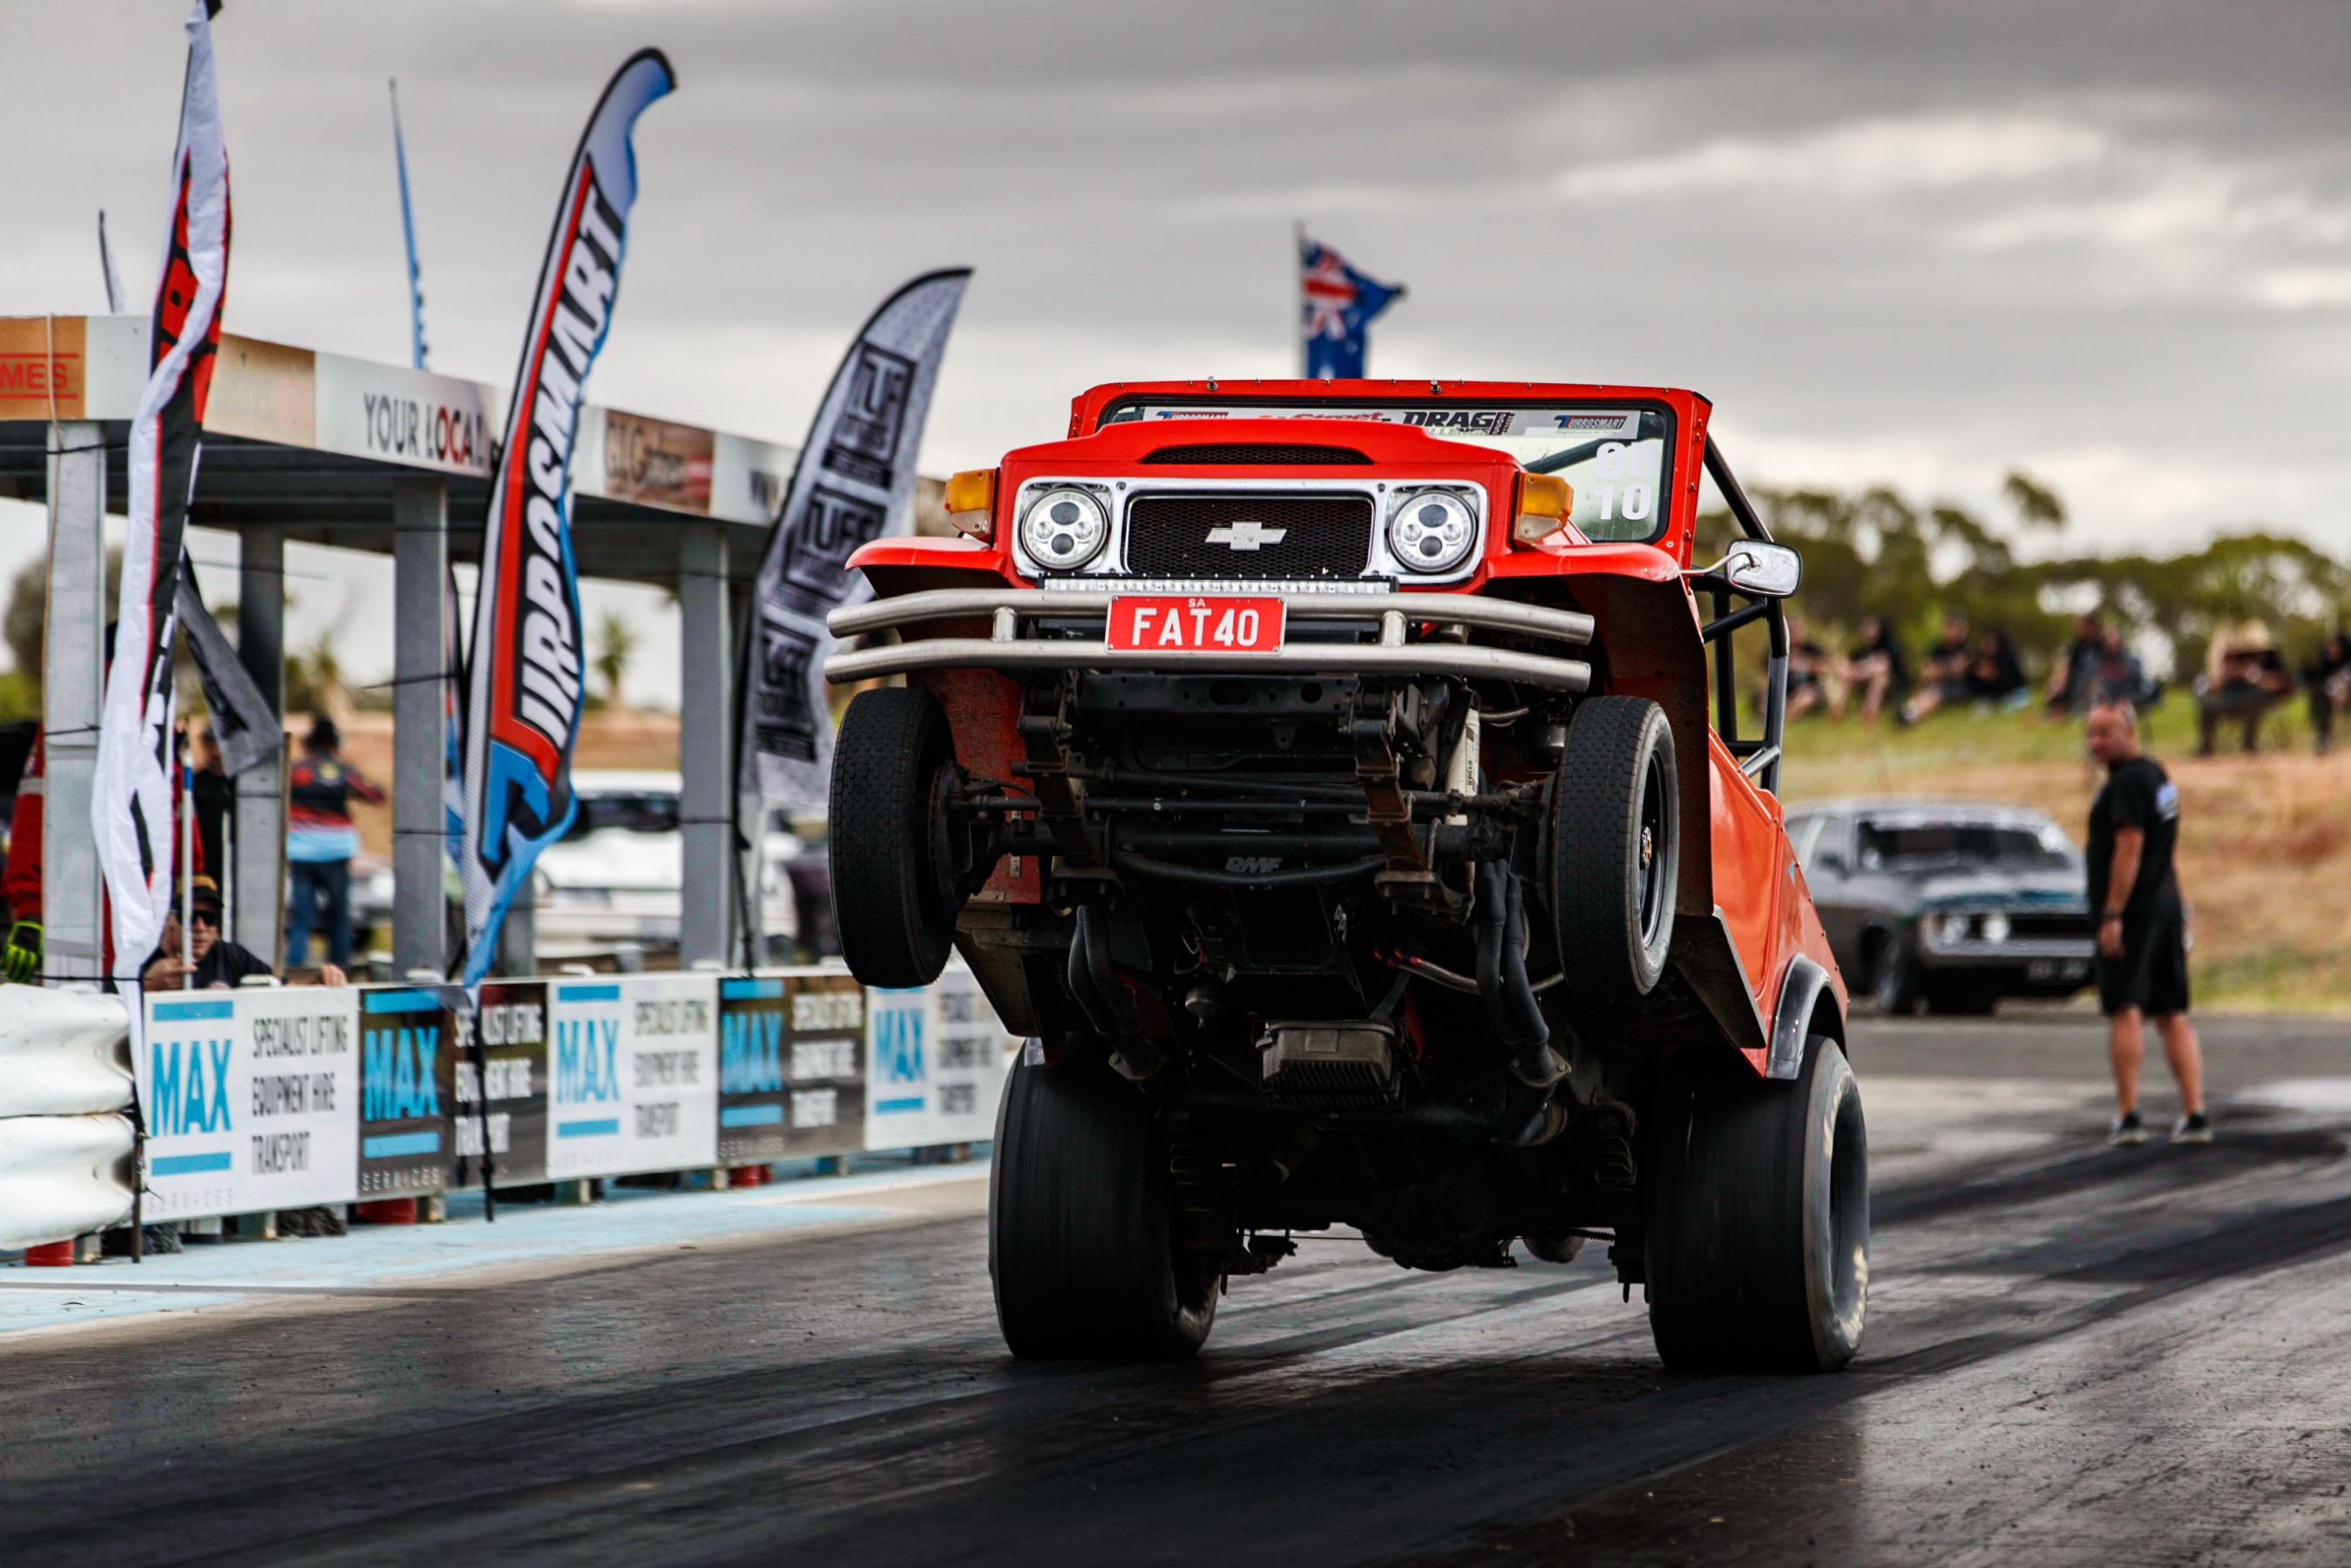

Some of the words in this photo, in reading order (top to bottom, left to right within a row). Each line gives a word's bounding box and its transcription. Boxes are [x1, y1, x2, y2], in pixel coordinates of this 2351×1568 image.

[363, 393, 419, 457] YOUR
[1403, 411, 1498, 428] DRAG
[1554, 415, 1628, 429] TURBOSMART
[1594, 483, 1652, 520] 10
[1132, 607, 1260, 647] FAT40
[1188, 598, 1206, 608] SA
[364, 1025, 440, 1122] MAX
[556, 1019, 621, 1105] MAX
[722, 1011, 783, 1094] MAX
[875, 1008, 925, 1085] MAX
[152, 1038, 233, 1138] MAX
